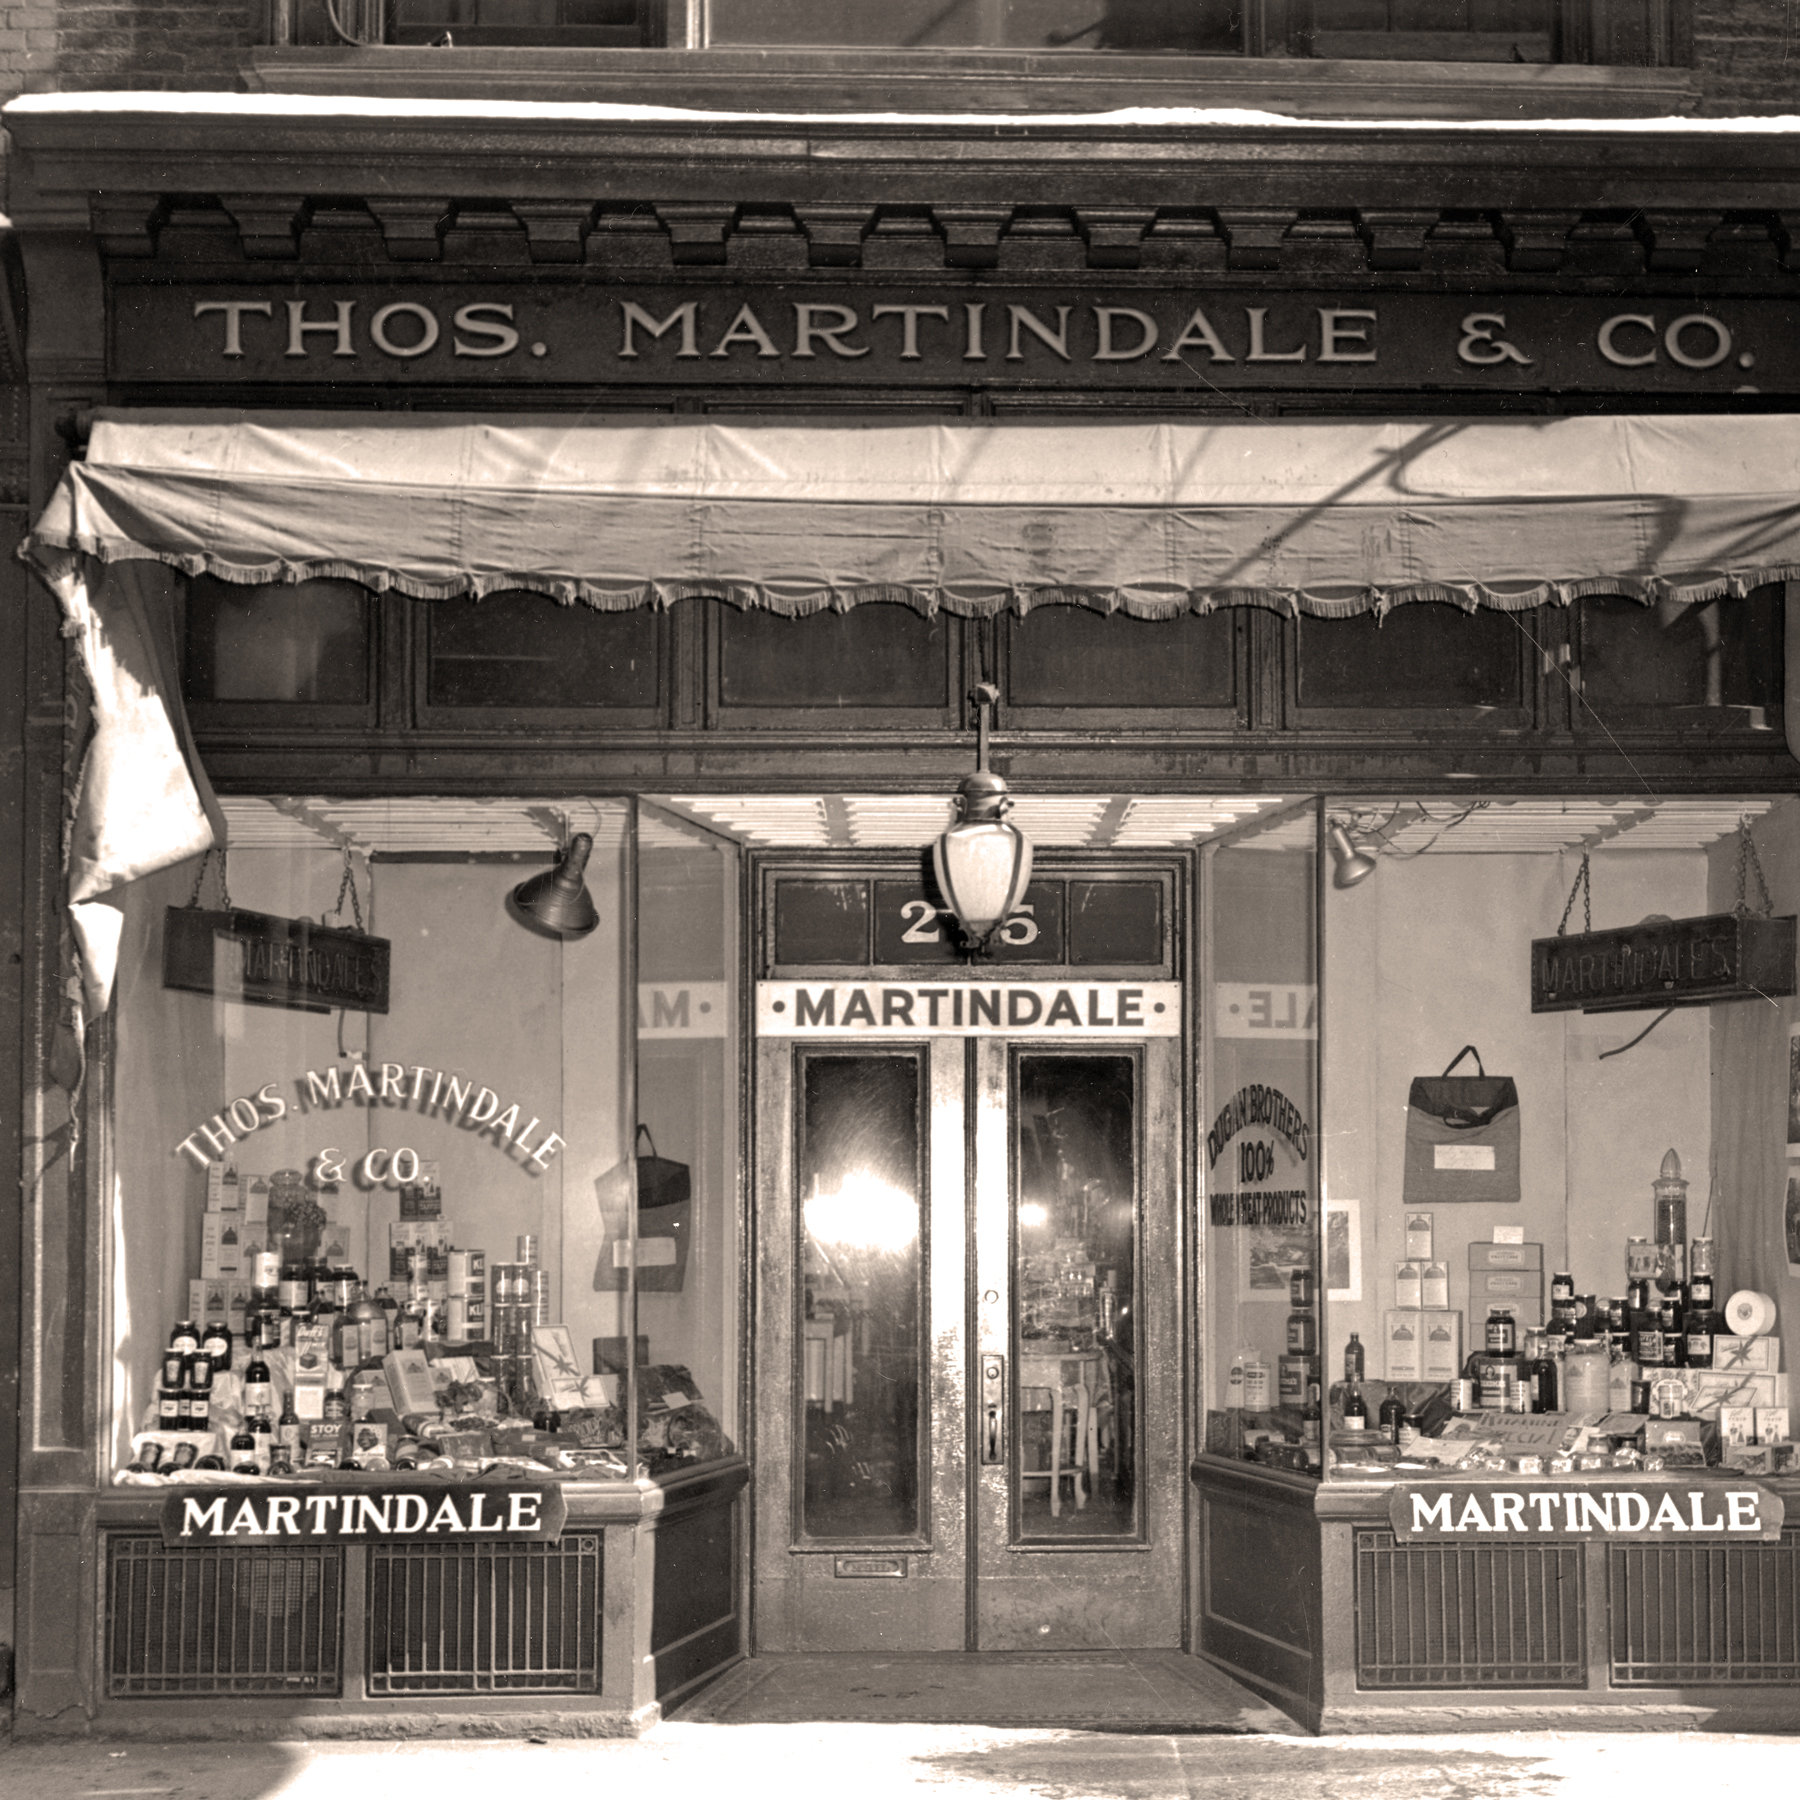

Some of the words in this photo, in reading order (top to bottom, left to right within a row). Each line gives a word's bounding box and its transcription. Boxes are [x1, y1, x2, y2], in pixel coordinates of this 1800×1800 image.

[193, 301, 550, 358] THOS.
[618, 302, 1378, 364] MARTINDALE
[1456, 313, 1535, 367] &
[1597, 313, 1757, 369] CO.
[794, 988, 1146, 1028] MARTINDALE
[175, 1083, 299, 1171] THOS.
[305, 1062, 570, 1171] MARTINDALE
[1207, 1086, 1247, 1171] DUGAN
[1249, 1083, 1311, 1162] BROTHERS
[315, 1147, 348, 1184] &
[363, 1147, 431, 1184] CO.
[1240, 1139, 1275, 1183] 100%
[1209, 1192, 1234, 1227] WHOLE
[1262, 1189, 1308, 1226] PRODUCTS
[310, 1424, 342, 1433] STOY
[180, 1492, 544, 1538] MARTINDALE
[1409, 1490, 1762, 1534] MARTINDALE
